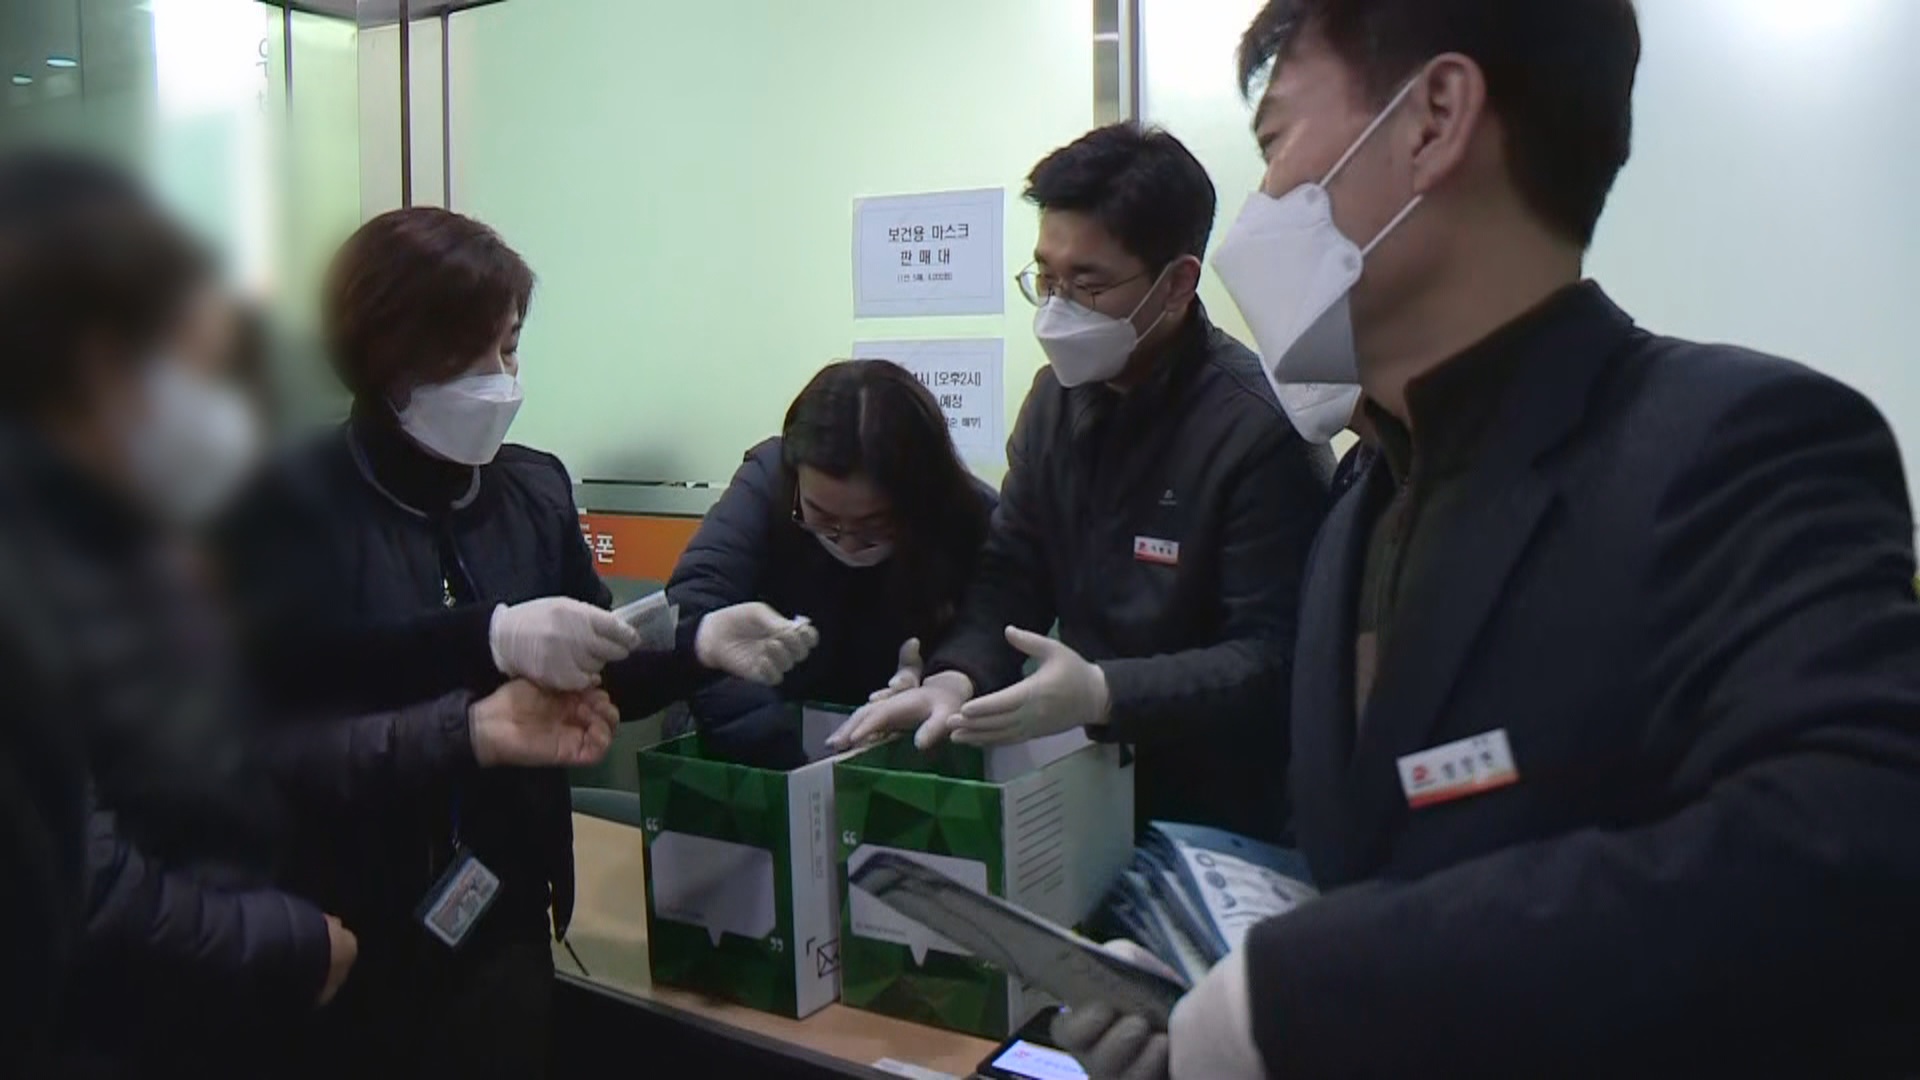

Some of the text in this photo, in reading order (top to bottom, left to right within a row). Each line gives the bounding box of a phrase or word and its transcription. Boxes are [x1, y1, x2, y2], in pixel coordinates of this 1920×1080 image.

[888, 223, 969, 242] 보건용 마스크
[940, 394, 963, 409] 예정
